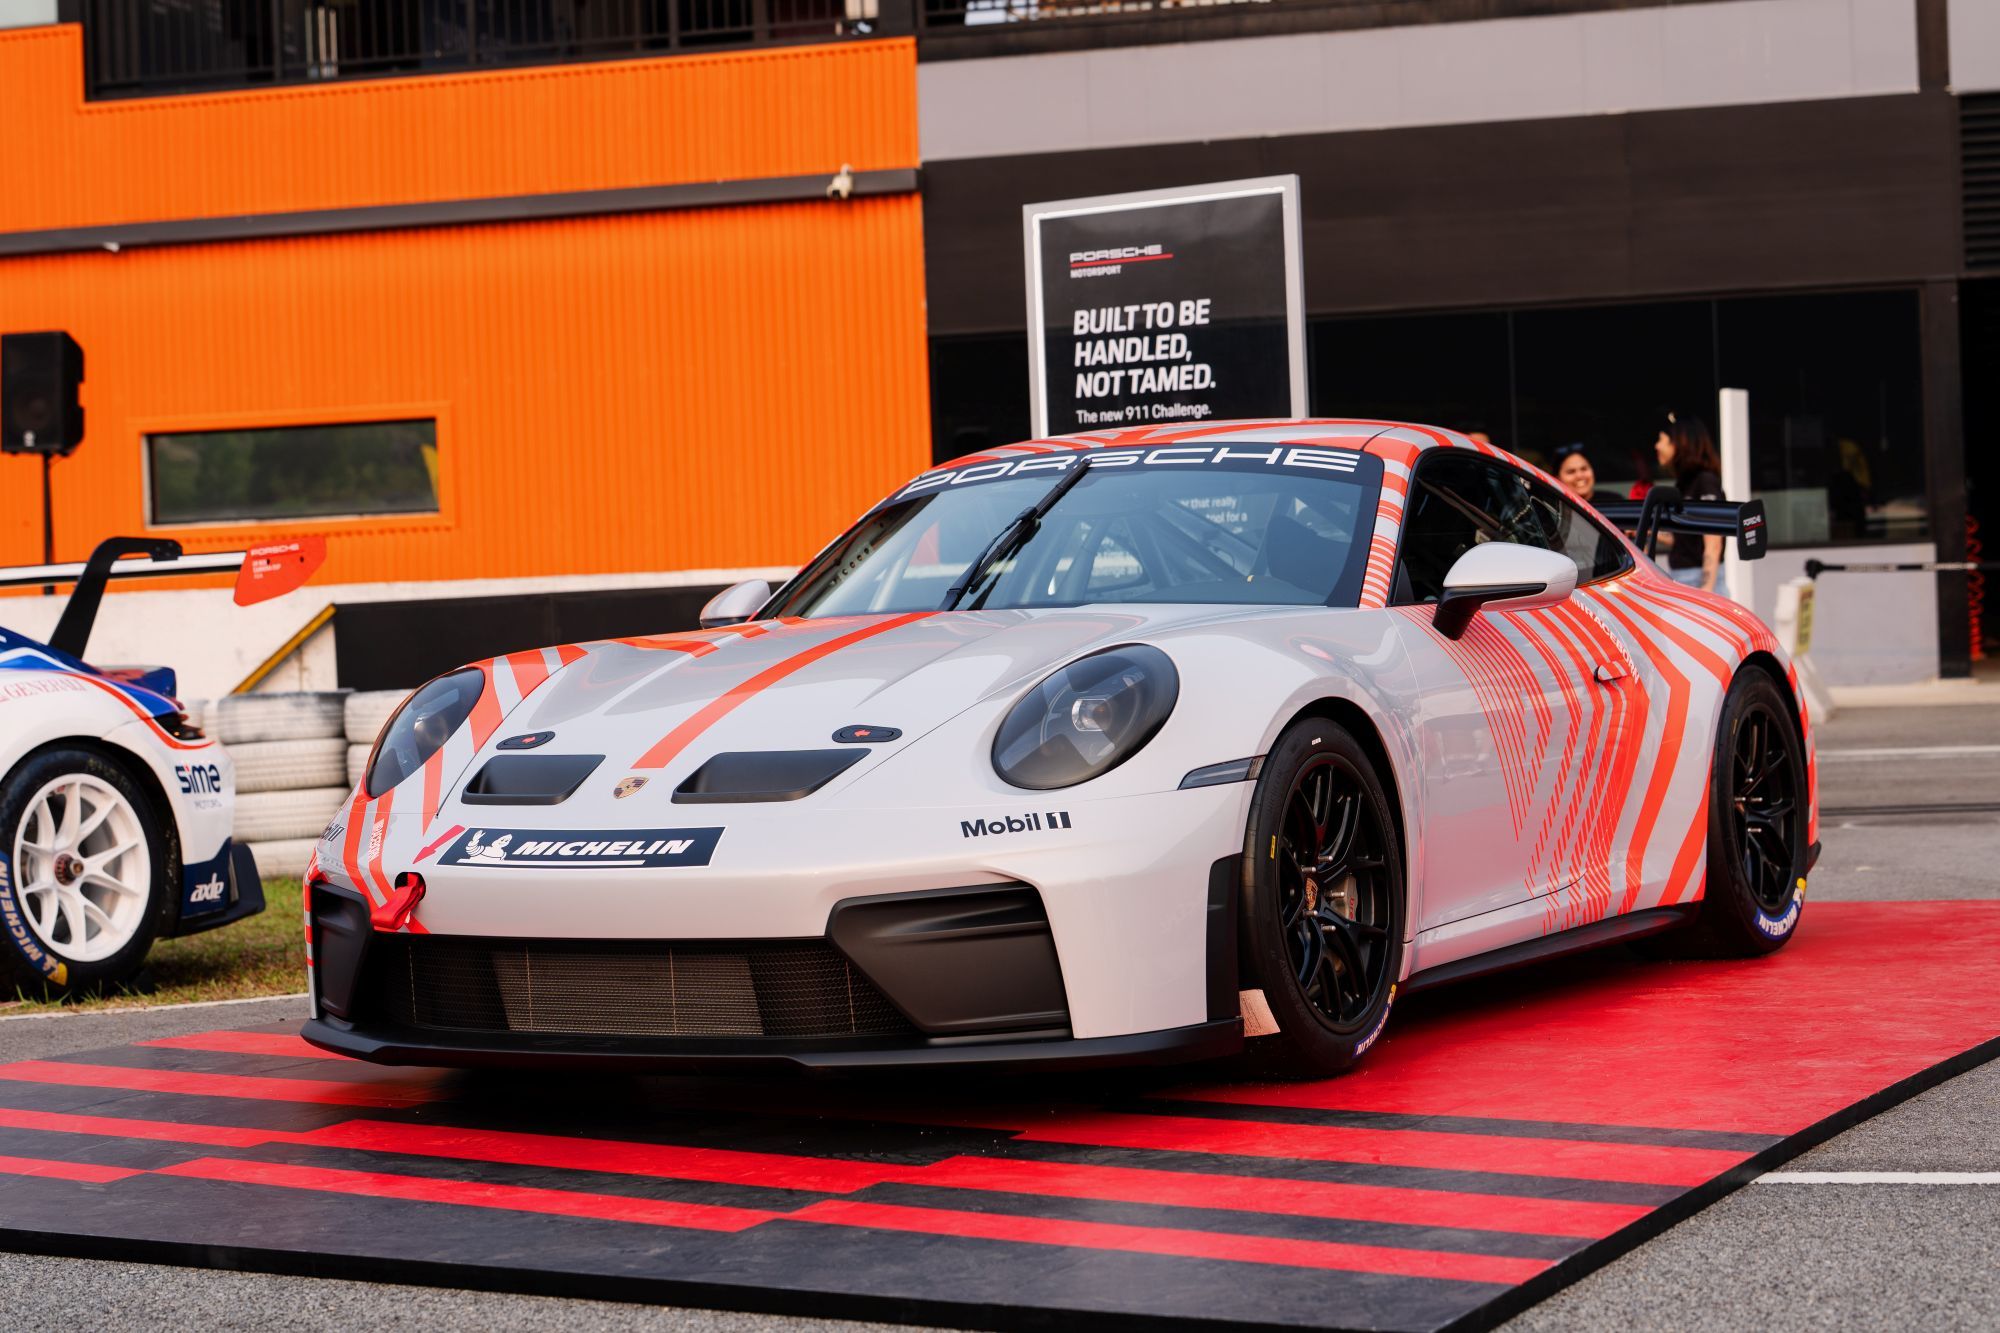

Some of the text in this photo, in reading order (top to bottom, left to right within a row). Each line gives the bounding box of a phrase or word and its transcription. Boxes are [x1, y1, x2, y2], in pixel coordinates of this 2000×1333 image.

[1069, 244, 1162, 263] PORSCHE
[1070, 264, 1122, 279] MOTORSPORT
[1073, 298, 1211, 336] BUILT TO BE
[1074, 333, 1192, 367] HANDLED,
[1075, 363, 1216, 399] NOT TAMED.
[1076, 402, 1212, 424] The new 911 Challenge.
[895, 446, 1361, 501] PORSCHE
[250, 543, 300, 556] PORSCHE
[960, 811, 1069, 838] Mobil 1
[511, 838, 695, 857] MICHELIN
[0, 860, 43, 961] MICHELIN
[1758, 903, 1798, 936] MICHELIN
[1355, 1006, 1389, 1056] MICHELIN
